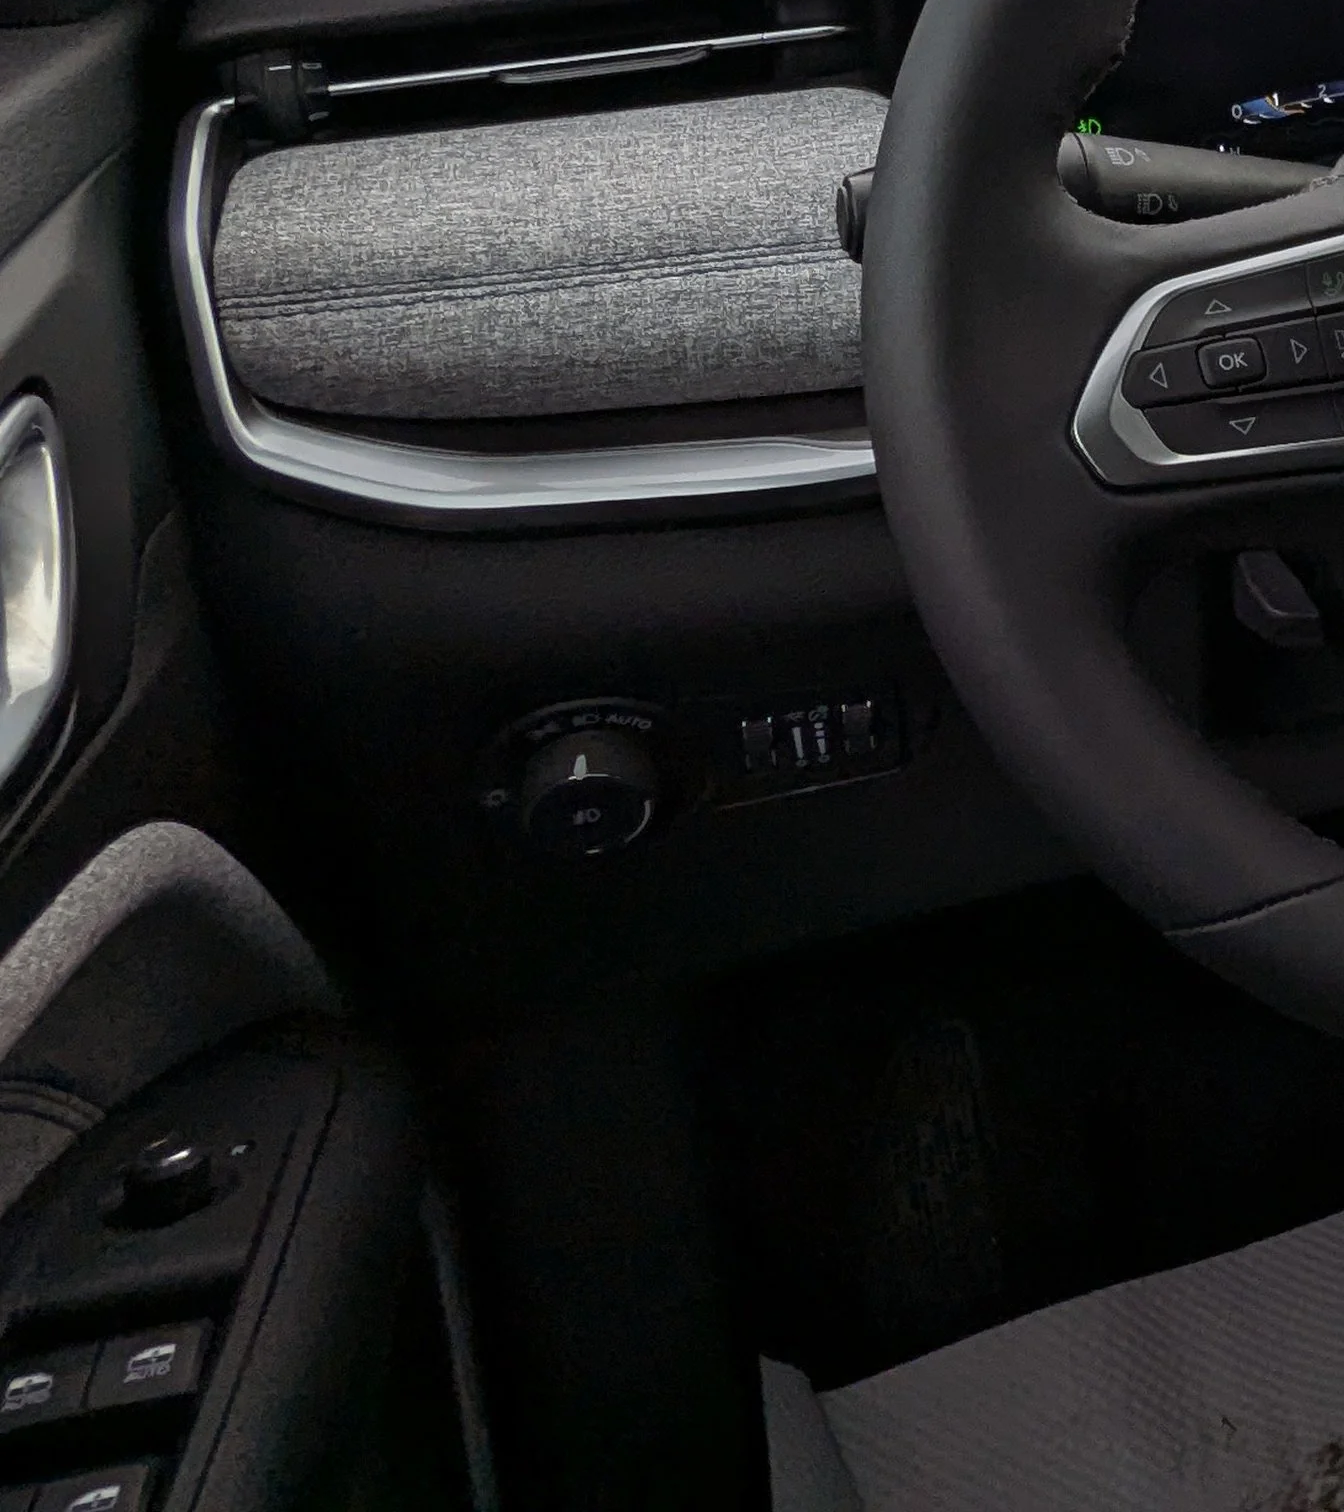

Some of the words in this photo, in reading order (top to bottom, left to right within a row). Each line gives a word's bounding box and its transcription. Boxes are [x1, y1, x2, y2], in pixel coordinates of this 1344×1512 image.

[1231, 104, 1243, 118] 0
[1272, 92, 1280, 107] 1
[1318, 84, 1327, 99] 2
[1218, 351, 1249, 371] OK
[604, 712, 653, 730] AUTO
